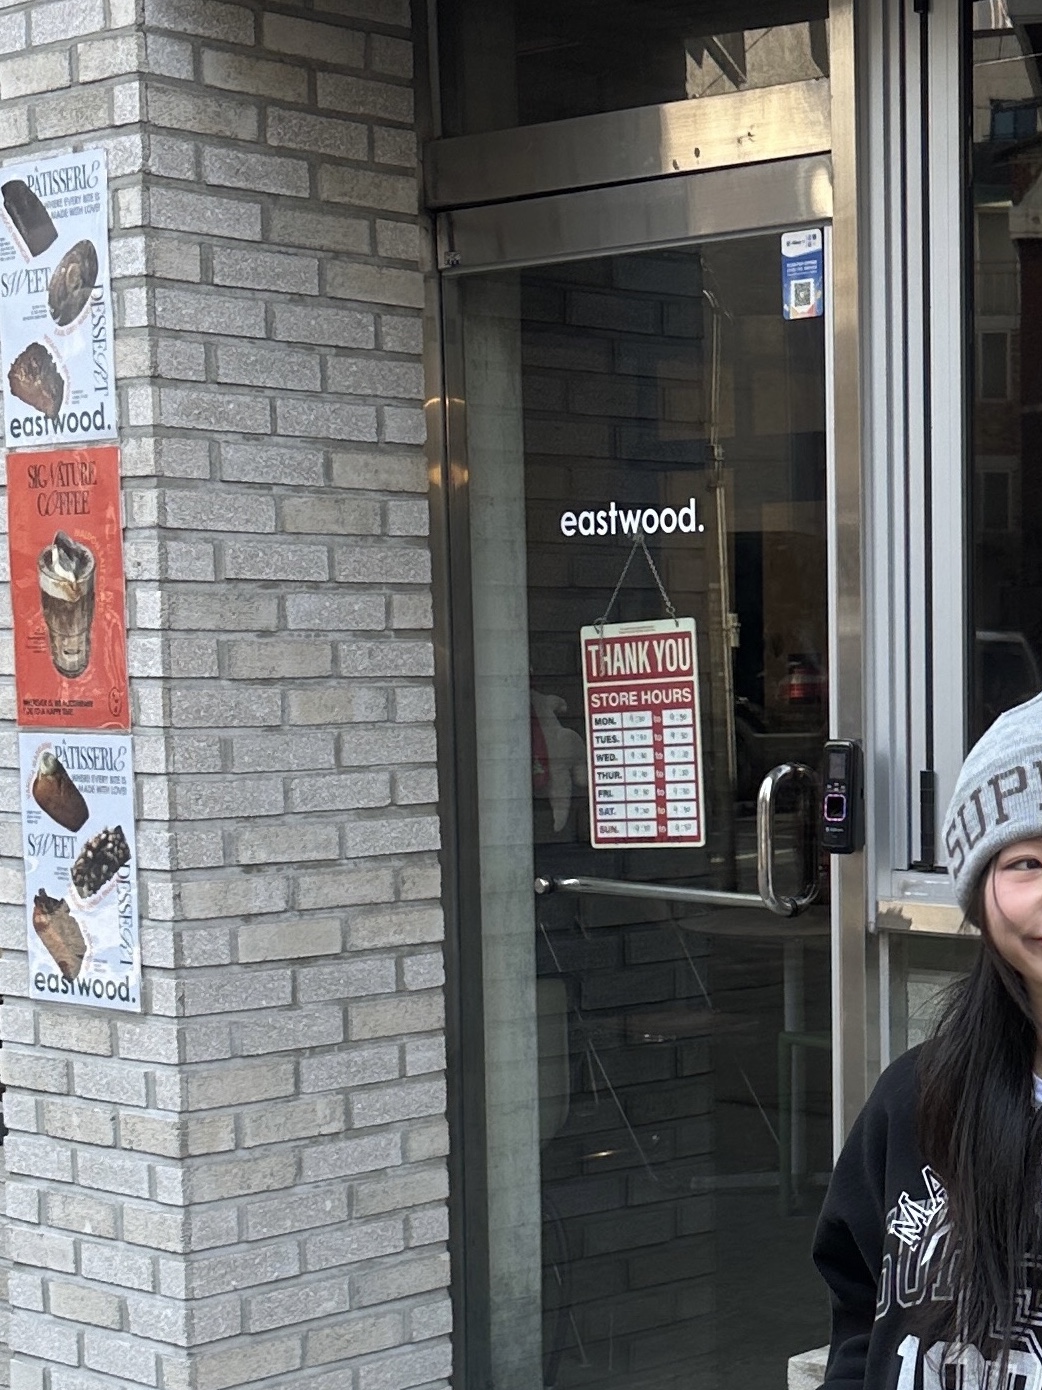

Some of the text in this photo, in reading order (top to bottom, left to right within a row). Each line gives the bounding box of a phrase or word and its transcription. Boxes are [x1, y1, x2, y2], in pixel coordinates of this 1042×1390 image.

[1, 267, 51, 297] SWEET
[91, 285, 108, 396] DESSERT
[37, 490, 91, 516] COFFEE
[560, 498, 704, 536] eastwood.
[588, 638, 691, 677] THANK YOU
[591, 688, 692, 707] STORE HOURS
[653, 715, 661, 723] to
[654, 733, 662, 741] to
[656, 770, 663, 778] to
[657, 788, 665, 796] to
[28, 833, 77, 859] SWEET
[117, 864, 134, 971] DESSERT
